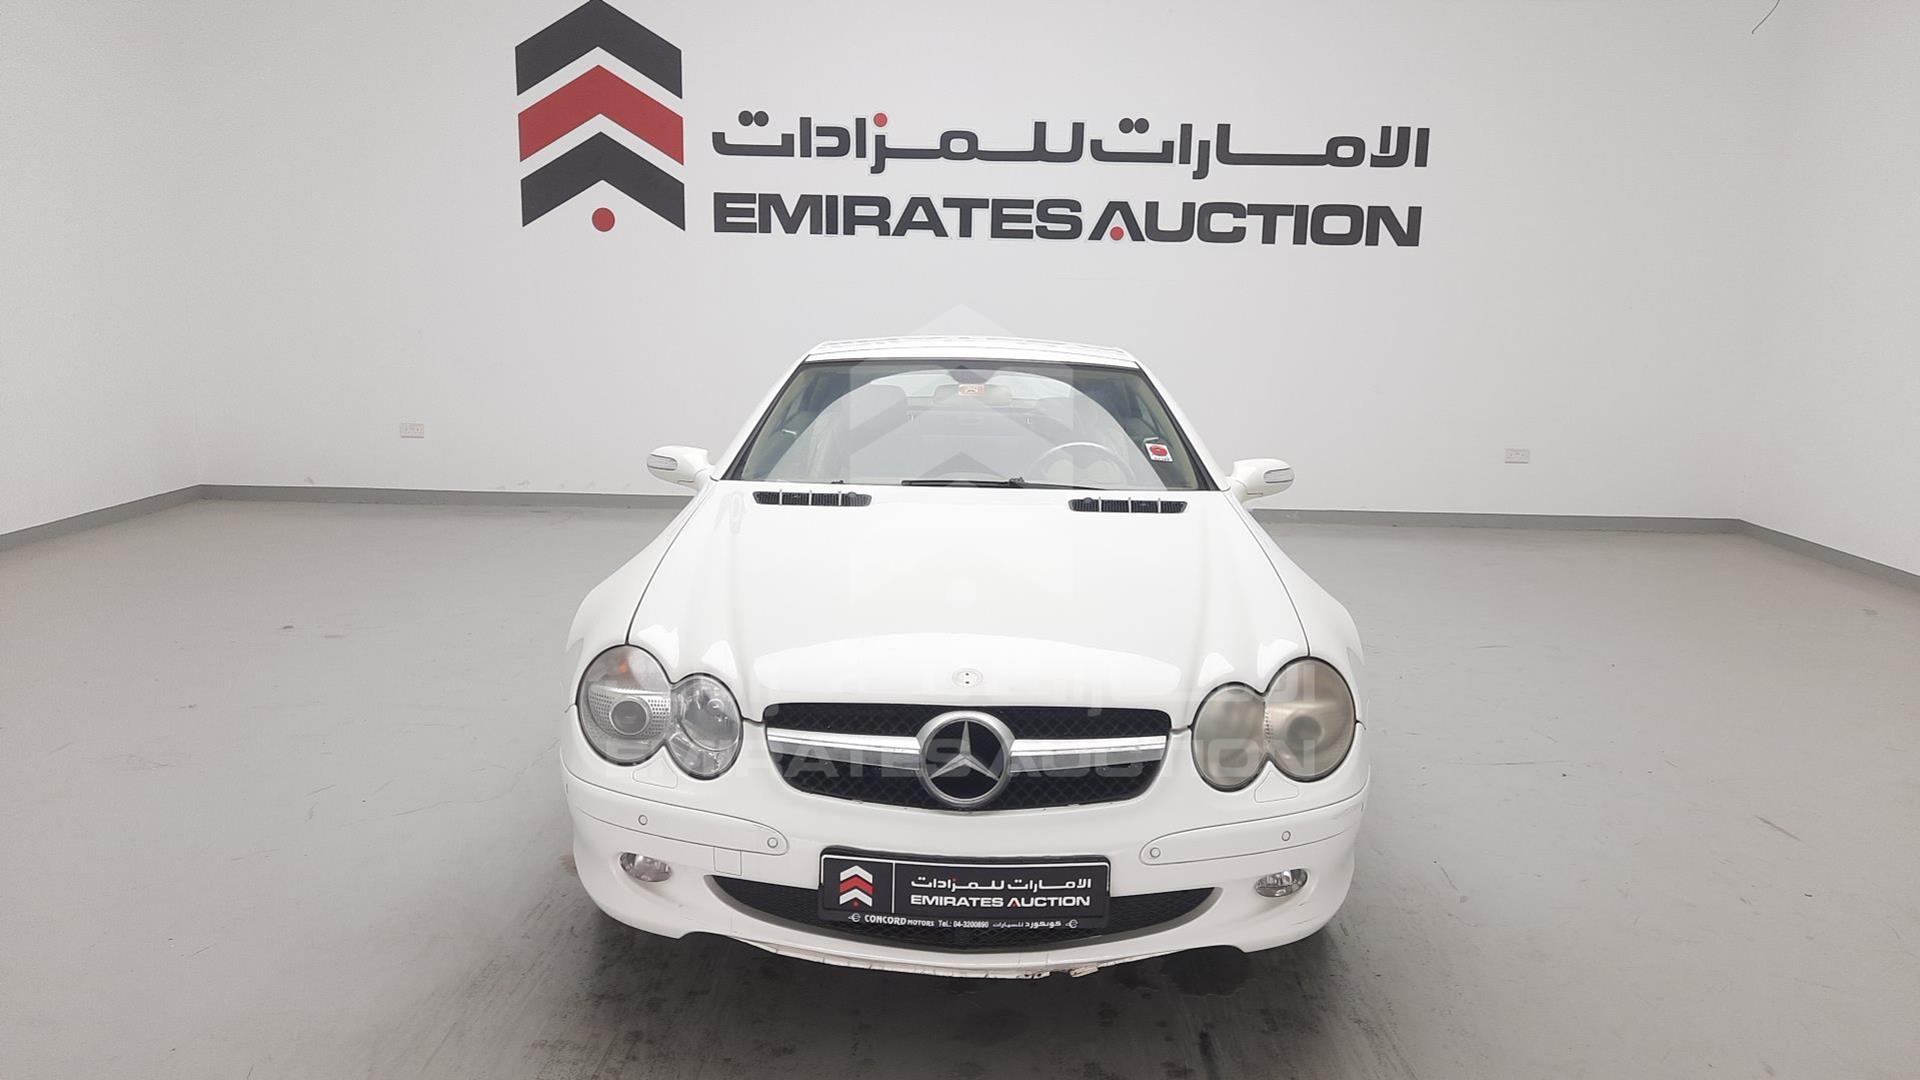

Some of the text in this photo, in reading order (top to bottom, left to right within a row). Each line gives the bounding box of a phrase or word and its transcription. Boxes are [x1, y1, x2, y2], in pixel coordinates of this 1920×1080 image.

[712, 110, 1430, 180] الامارات للمزادات
[714, 192, 1422, 247] EMIRATES AUCTION
[911, 876, 1092, 893] الامارات للمزادات
[910, 894, 1090, 909] EMIRATES AUCTION
[864, 914, 907, 925] CONCORD
[907, 919, 935, 927] MOTORS
